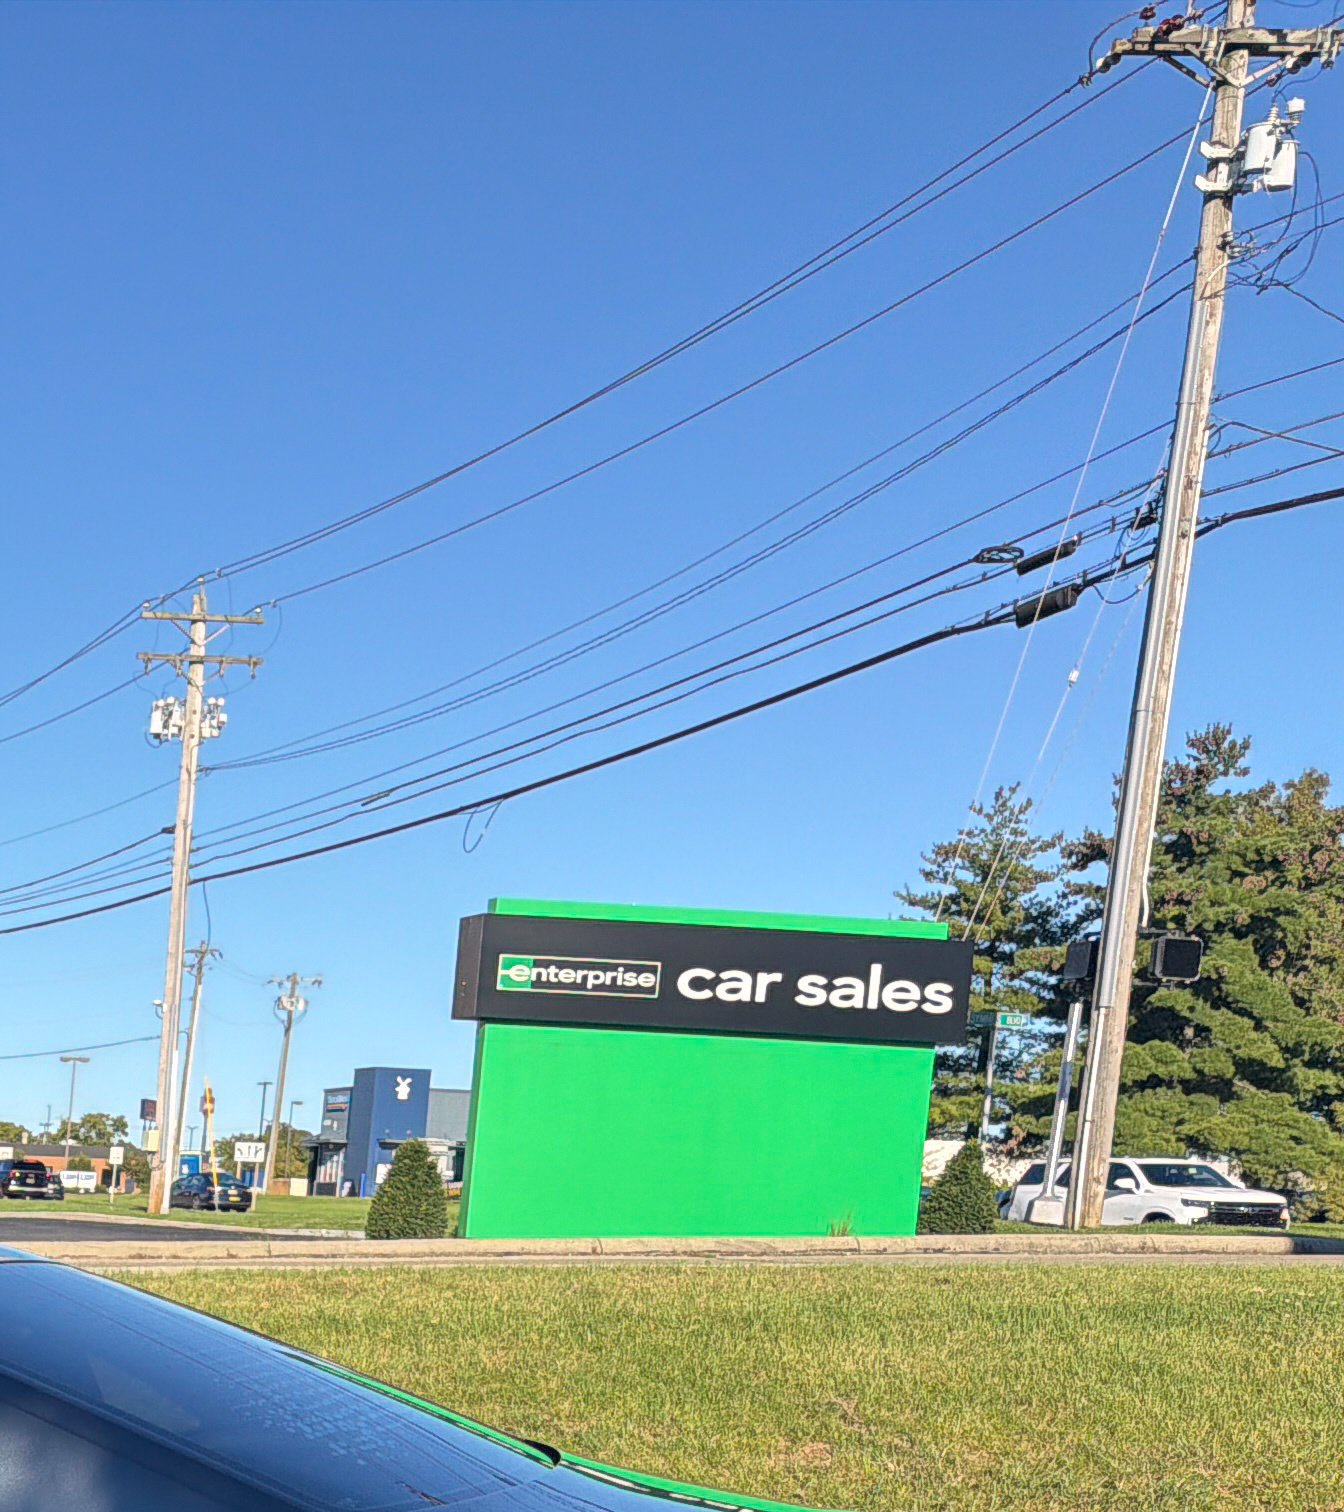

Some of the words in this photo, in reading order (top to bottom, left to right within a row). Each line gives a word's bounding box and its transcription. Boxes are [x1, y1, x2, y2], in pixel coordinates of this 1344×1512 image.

[507, 964, 656, 990] enterprise
[676, 967, 783, 1003] car
[794, 963, 954, 1014] sales
